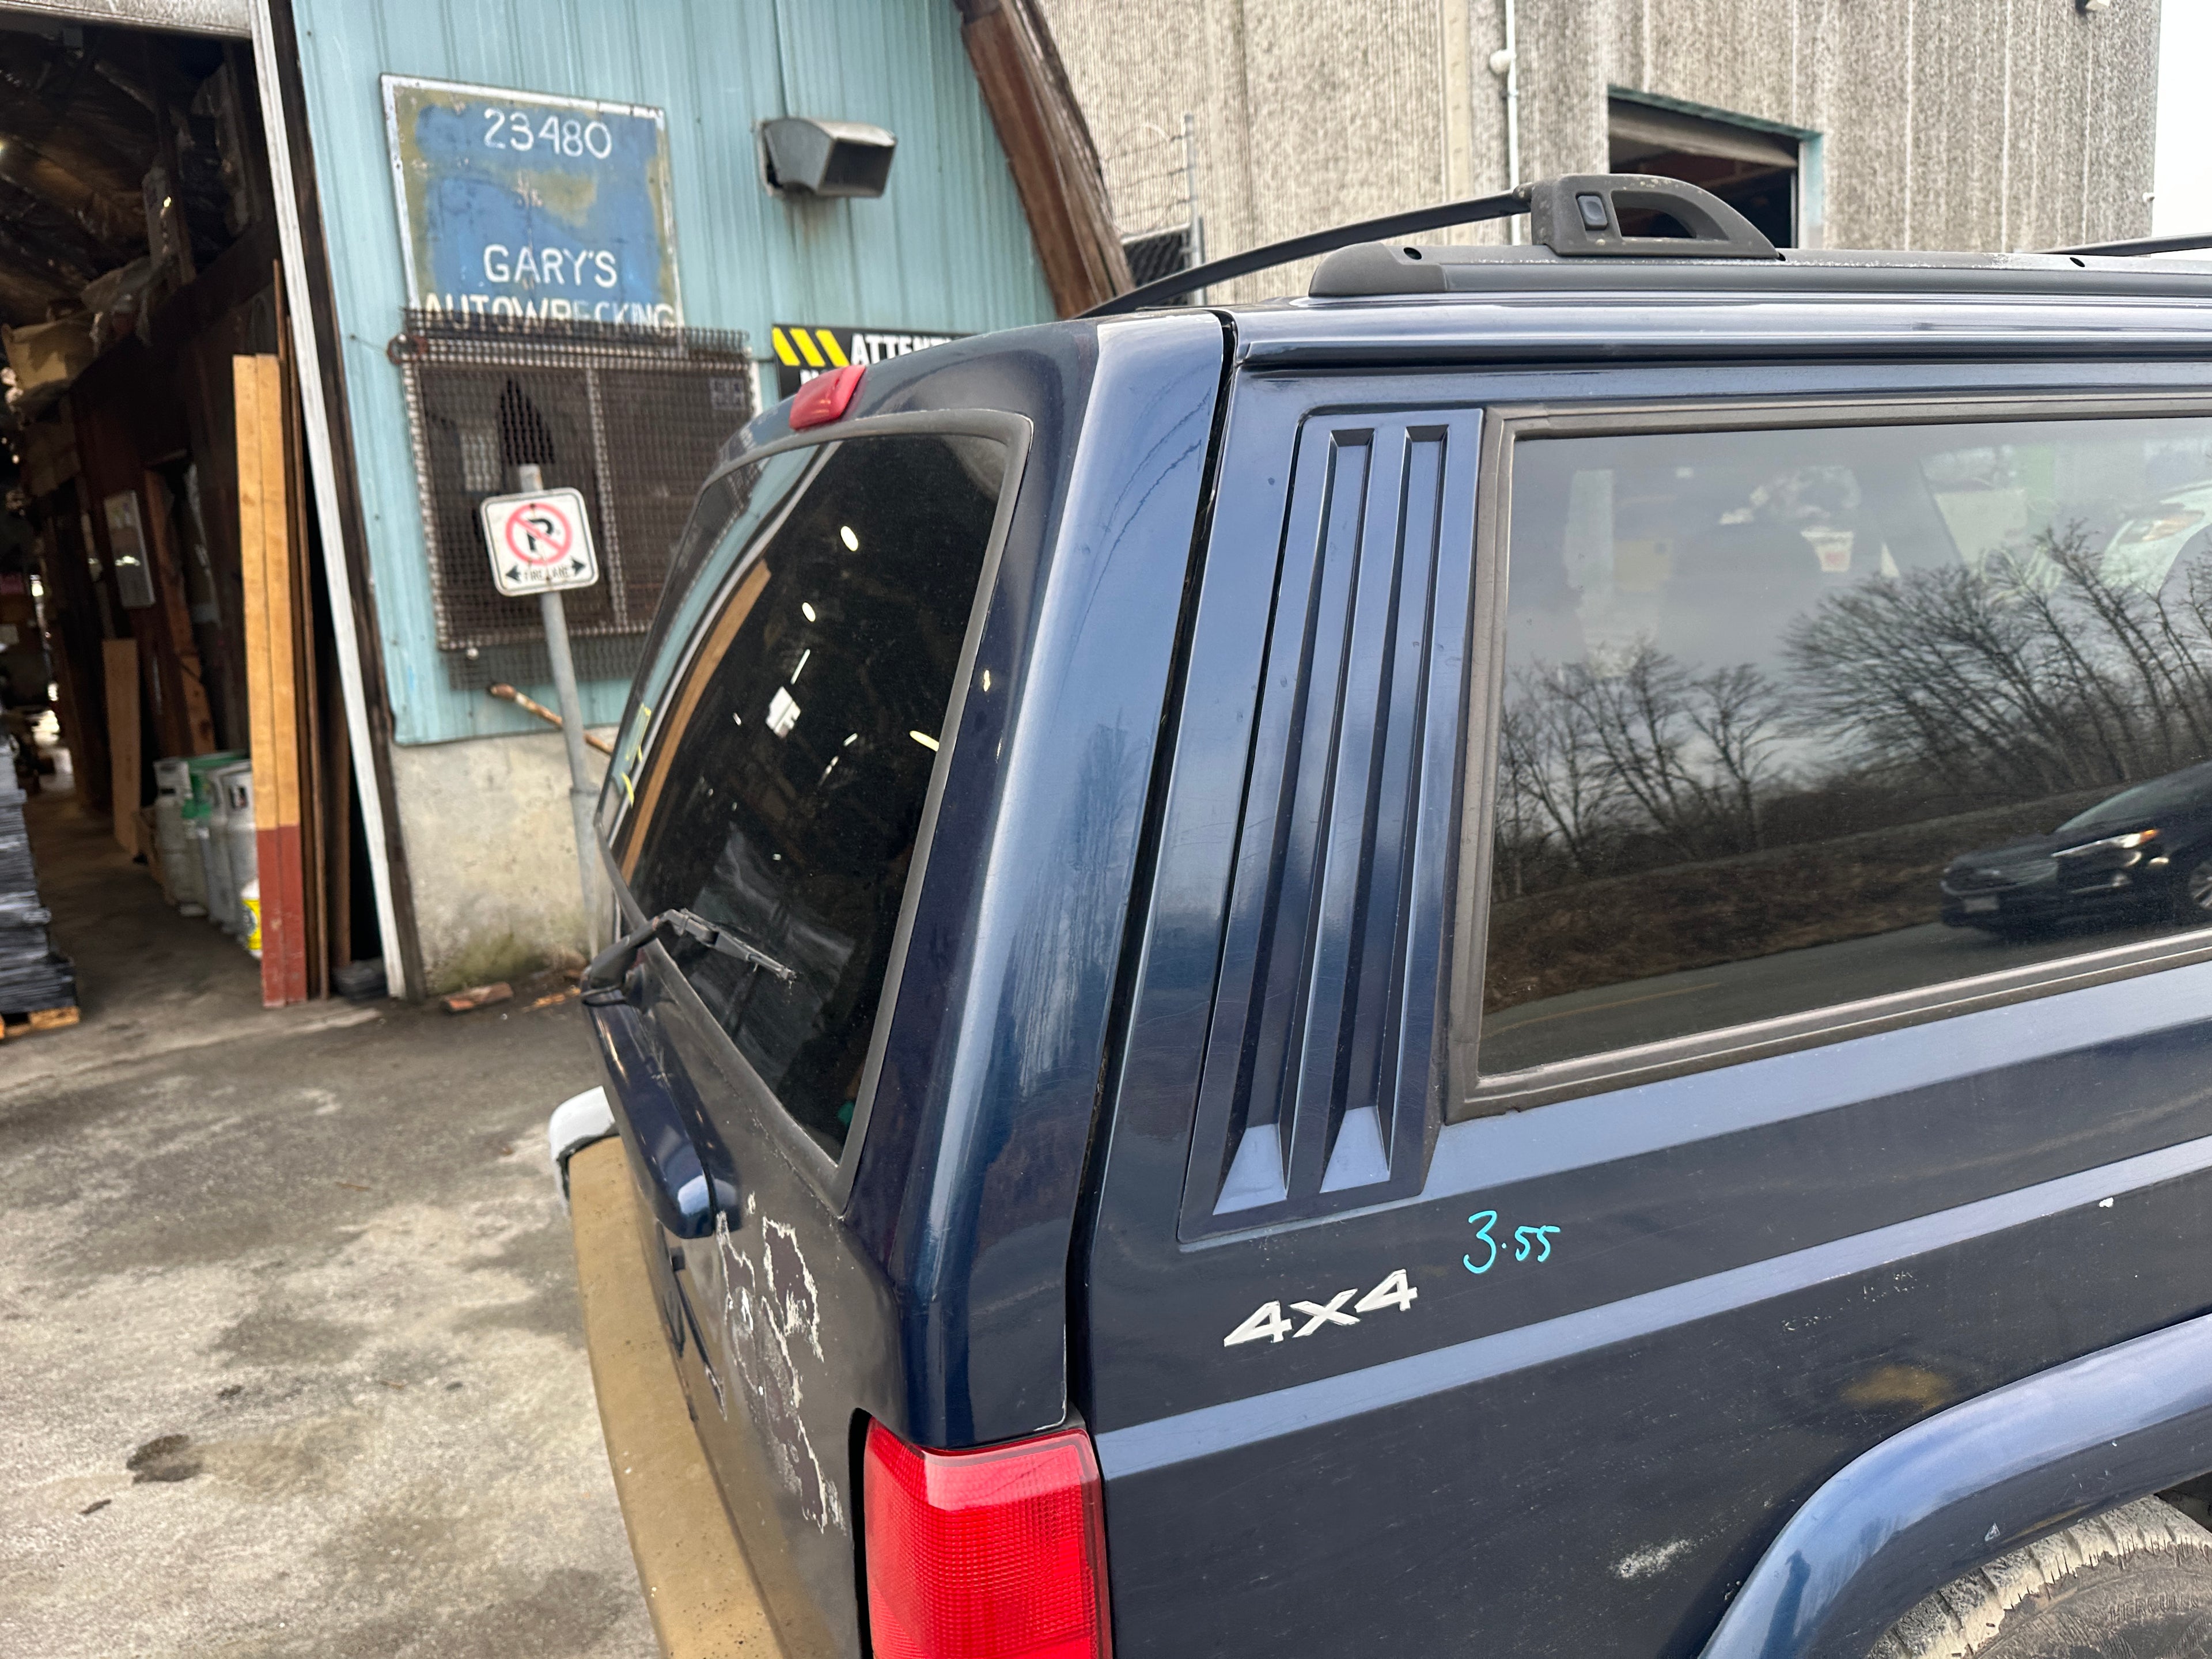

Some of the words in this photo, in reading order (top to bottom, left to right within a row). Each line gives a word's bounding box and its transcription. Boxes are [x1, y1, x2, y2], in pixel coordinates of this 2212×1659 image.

[483, 107, 612, 159] 23480
[482, 243, 618, 288] GARY'S
[1463, 1210, 1560, 1274] 3.55
